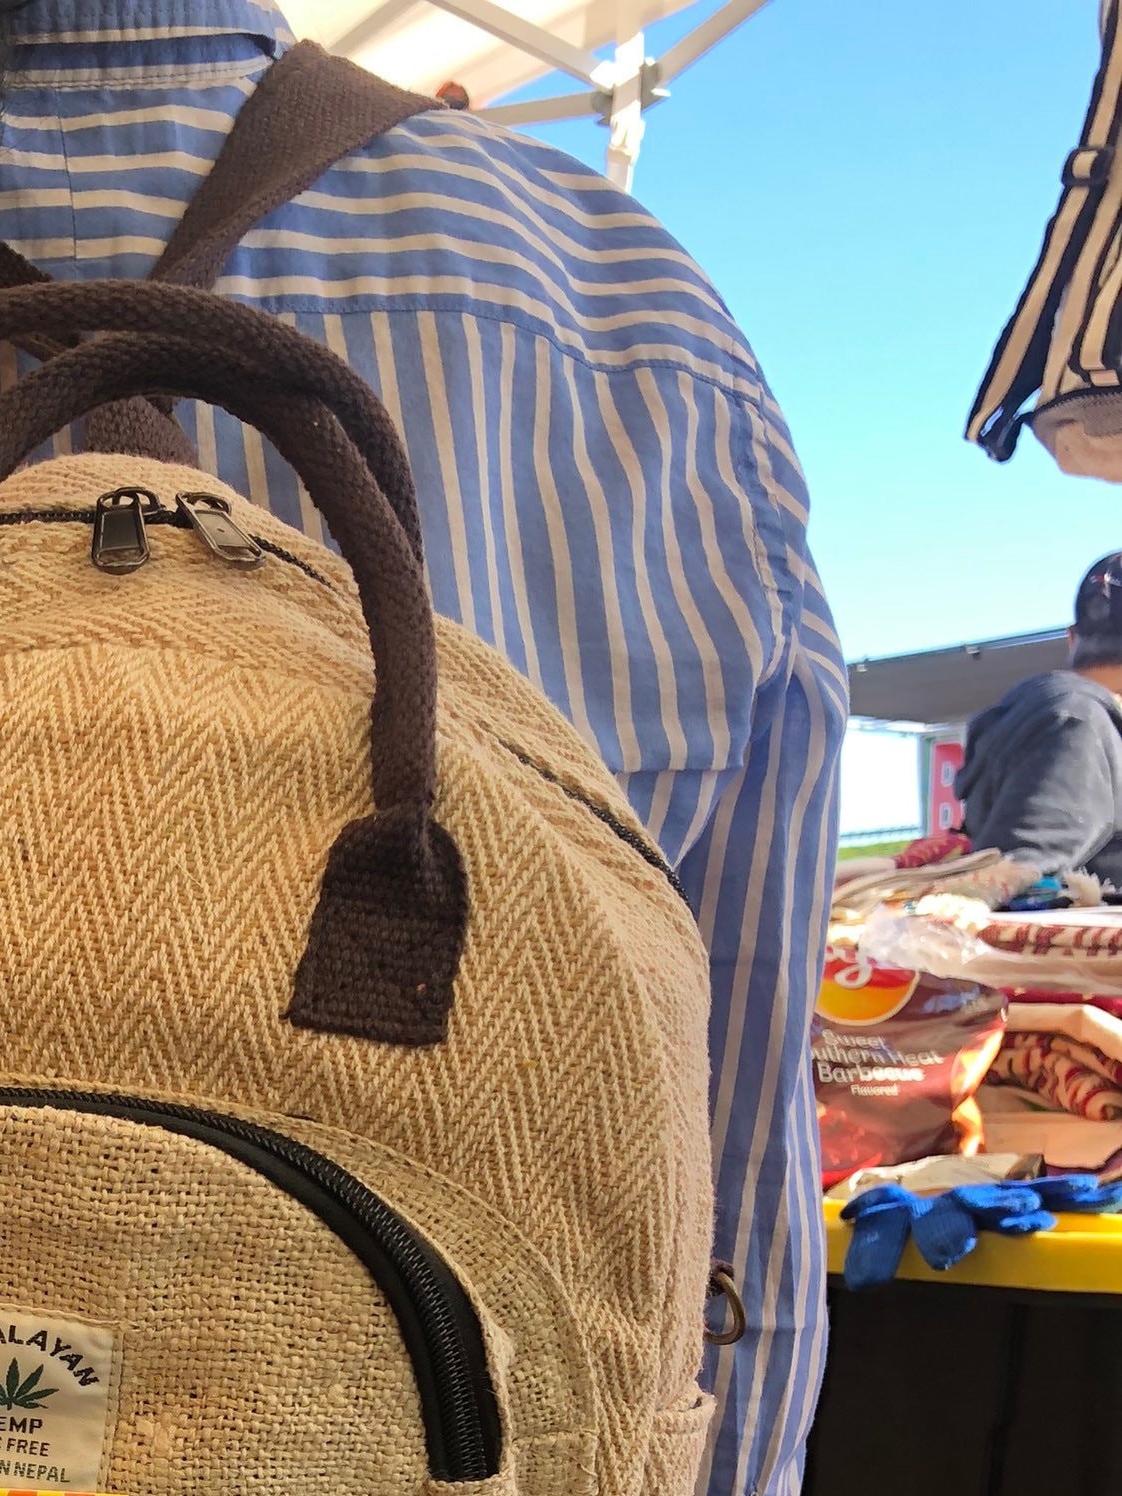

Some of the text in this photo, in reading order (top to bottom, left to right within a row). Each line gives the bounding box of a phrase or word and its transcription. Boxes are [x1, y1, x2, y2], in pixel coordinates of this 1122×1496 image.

[812, 1043, 887, 1064] uthern
[6, 1438, 50, 1457] FREE
[13, 1461, 70, 1483] NEPAL
